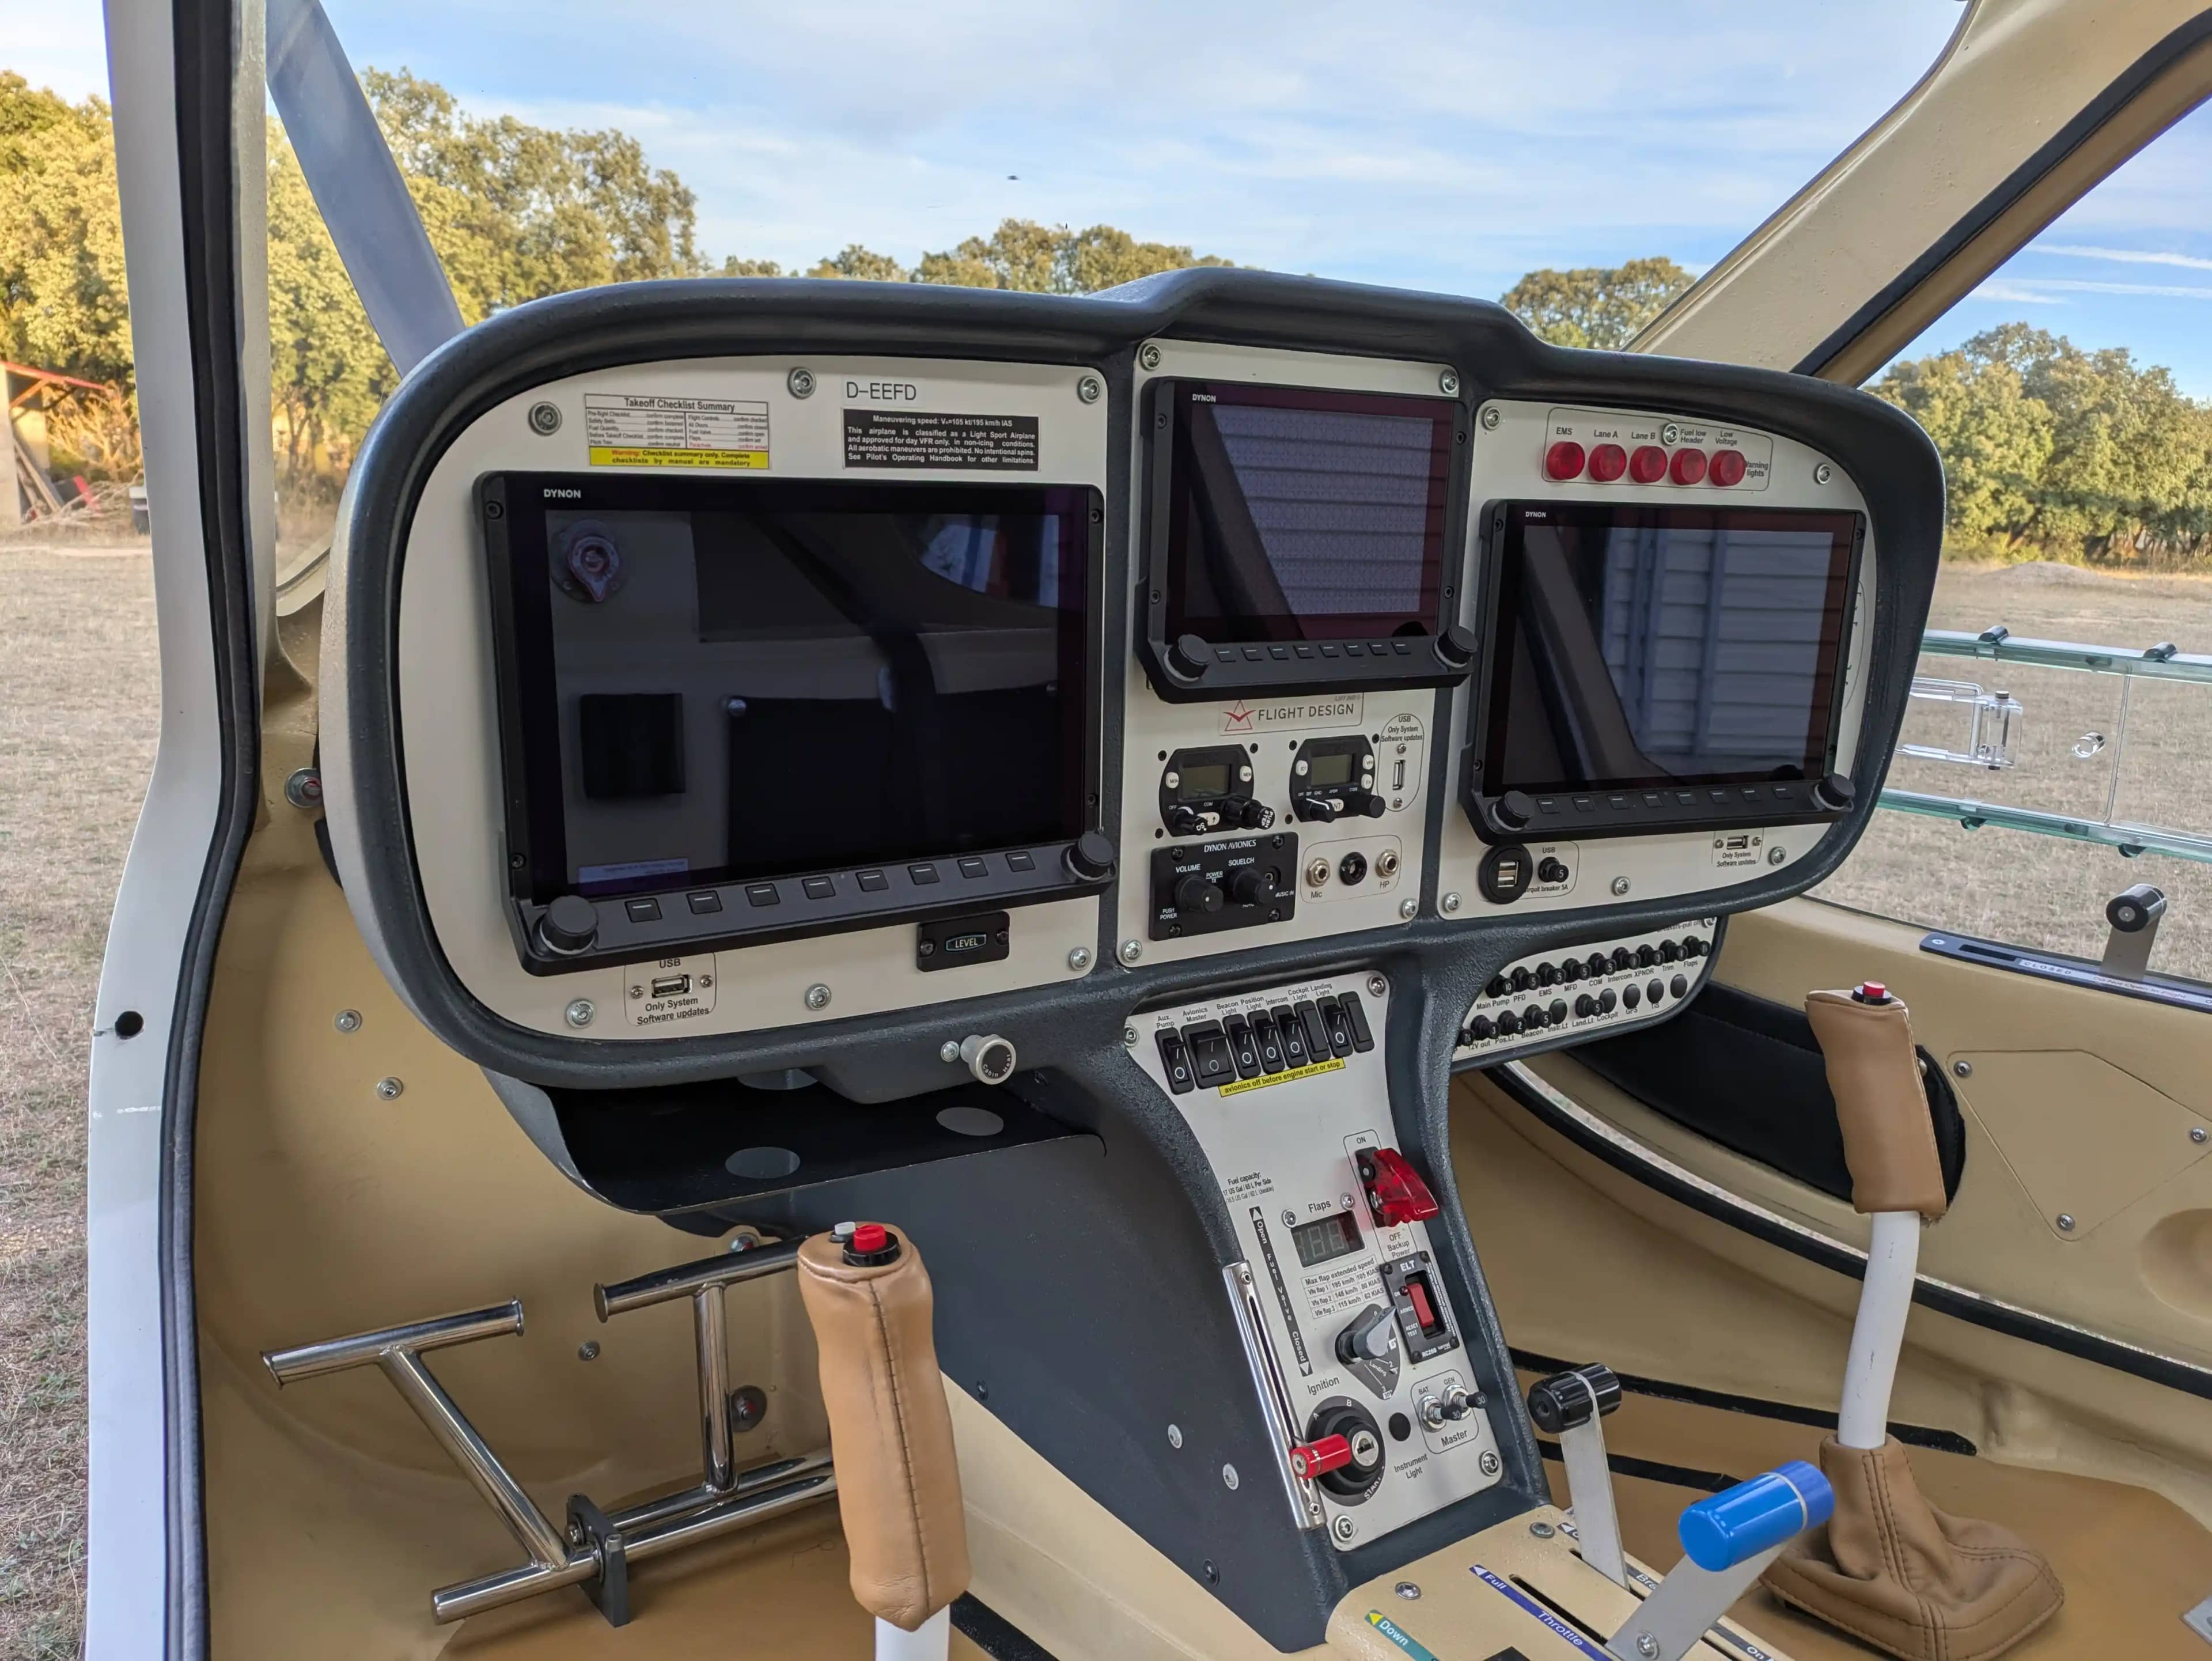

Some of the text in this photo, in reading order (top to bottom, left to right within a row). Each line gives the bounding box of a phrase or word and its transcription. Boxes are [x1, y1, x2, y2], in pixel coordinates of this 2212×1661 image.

[847, 381, 916, 400] D-EEFD
[1192, 393, 1217, 403] DYNON
[624, 398, 735, 413] Takeoff Checklist Summary
[873, 415, 916, 425] Maneuvering
[869, 427, 896, 436] airplane
[970, 431, 986, 439] Light
[1010, 432, 1035, 440] Airplane
[1556, 427, 1573, 436] EMS
[1594, 430, 1618, 438] Lane A
[862, 437, 893, 445] approved
[964, 440, 994, 448] non-icing
[1715, 437, 1738, 447] Voltage
[939, 448, 973, 456] prohibited.
[892, 454, 925, 463] Operating
[1747, 470, 1764, 478] lights
[544, 489, 581, 498] DYNON
[1258, 703, 1354, 721] FLIGHT DESIGN
[1388, 725, 1419, 734] Only System
[1404, 734, 1423, 742] updates
[1204, 839, 1256, 853] DYNON AVIONICS
[1228, 857, 1255, 867] SQUELCH
[1176, 864, 1201, 873] VOLUME
[1559, 869, 1565, 879] 5
[1380, 880, 1389, 890] HP
[1311, 891, 1323, 899] Mic
[955, 937, 978, 948] LEVEL
[659, 958, 681, 968] USB
[1662, 964, 1674, 972] Trim
[1683, 960, 1698, 968] Flaps
[1634, 968, 1654, 978] XPNDR
[2024, 962, 2071, 975] CLOSED
[1589, 978, 1603, 986] COM
[1608, 973, 1633, 983] Intercom
[1288, 986, 1309, 996] Cockpit
[1310, 983, 1332, 992] Landing
[1563, 983, 1578, 992] MFD
[1293, 993, 1308, 1001] Light
[1513, 994, 1526, 1002] PFD
[1539, 989, 1552, 997] EMS
[645, 997, 699, 1012] Only System
[1240, 996, 1264, 1005] Position
[1266, 997, 1289, 1005] Intercom
[1476, 998, 1510, 1010] Main Pump
[1217, 1002, 1239, 1010] Beacon
[1247, 1003, 1262, 1011] Light
[637, 1007, 709, 1025] Software updates
[1183, 1007, 1208, 1017] Avionics
[1221, 1008, 1237, 1016] Light
[1187, 1015, 1207, 1023] Master
[1572, 1017, 1594, 1027] Land.Lt
[1156, 1021, 1175, 1030] Pump
[1521, 1030, 1543, 1039] Beacon
[983, 1064, 999, 1077] Cabin
[1224, 1083, 1251, 1094] avionics
[1262, 1076, 1282, 1084] before
[1283, 1070, 1303, 1081] engine
[1305, 1066, 1319, 1074] start
[1327, 1061, 1340, 1070] stop
[1356, 1136, 1366, 1144] ON
[1228, 1176, 1240, 1186] Fuel
[1308, 1201, 1331, 1213] Flaps
[1389, 1232, 1402, 1242] OFF
[1387, 1240, 1410, 1252] Backup
[1391, 1248, 1410, 1259] Power
[1399, 1259, 1415, 1272] ELT
[1305, 1257, 1374, 1286] Max flap extended speed
[1342, 1266, 1379, 1285] km/h KIAS
[1257, 1221, 1306, 1361] Open Fuel Valve Closed
[1345, 1277, 1381, 1295] km/h KIAS
[1348, 1287, 1384, 1305] km/h KIAS
[1405, 1323, 1418, 1331] RESET
[1307, 1376, 1340, 1395] Ignition
[1443, 1376, 1456, 1386] GEN
[1418, 1386, 1430, 1395] BAT
[1477, 1396, 1486, 1405] 30
[1452, 1410, 1461, 1419] 30
[1441, 1430, 1468, 1447] Master
[1394, 1454, 1428, 1473] Instrument
[1406, 1467, 1423, 1480] Light
[1484, 1574, 1584, 1646] Full Throttle
[1379, 1620, 1408, 1646] Down
[1747, 1646, 1764, 1660] On
